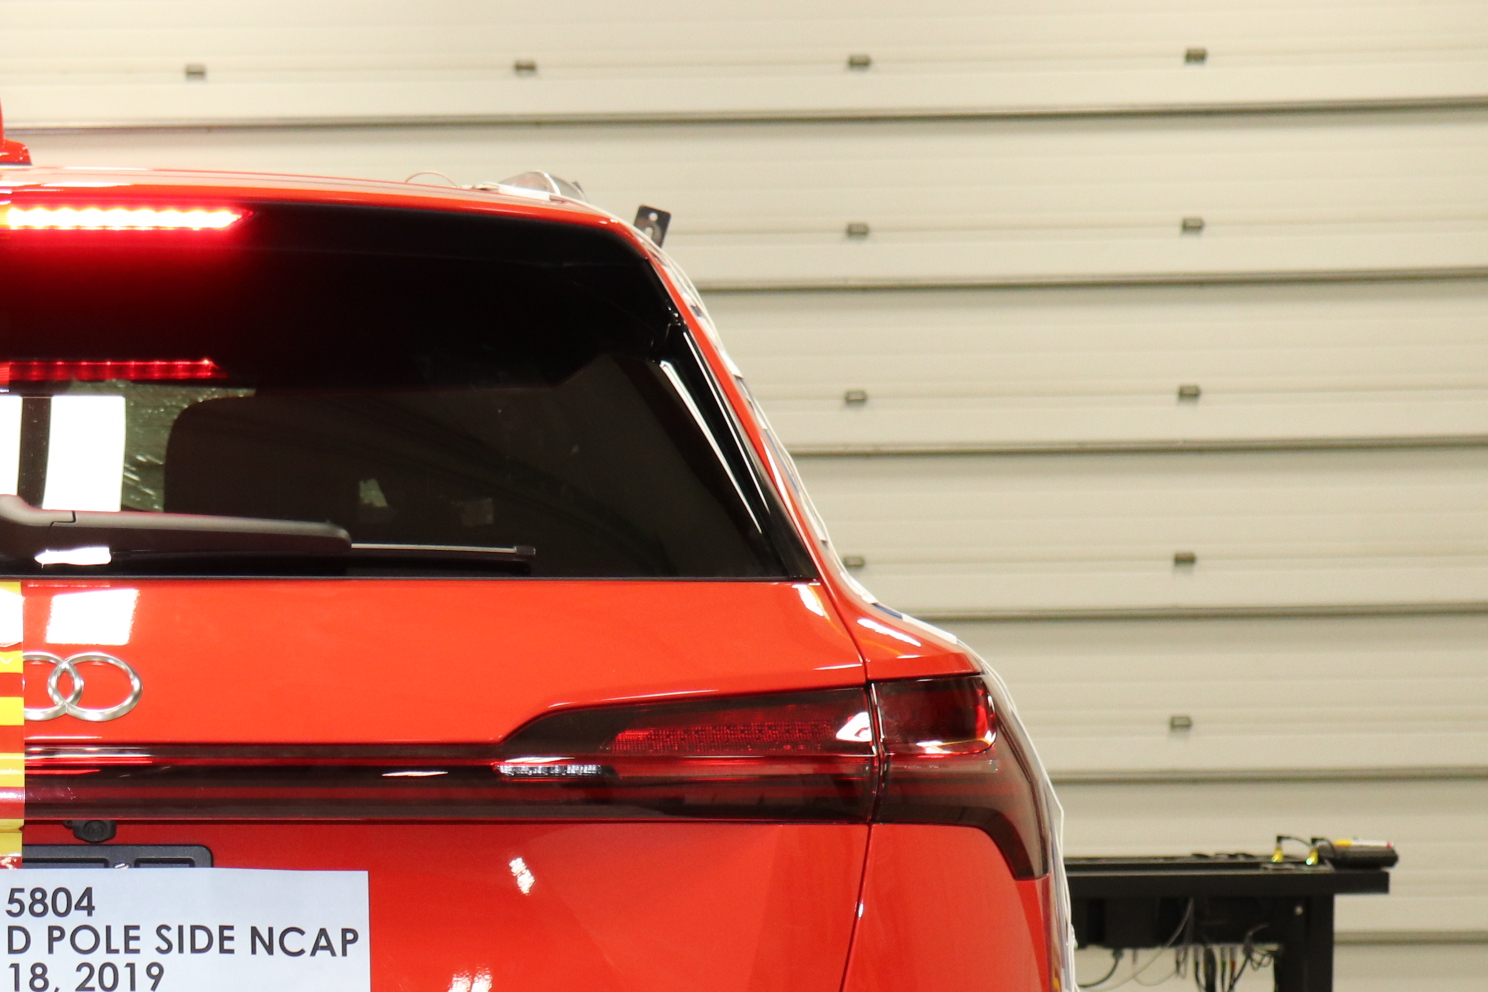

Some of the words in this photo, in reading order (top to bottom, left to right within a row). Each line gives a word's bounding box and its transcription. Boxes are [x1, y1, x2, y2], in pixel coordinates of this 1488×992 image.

[47, 924, 141, 955] POLE
[155, 924, 235, 955] SIDE
[250, 925, 359, 957] NCAP
[75, 961, 165, 992] 2019
